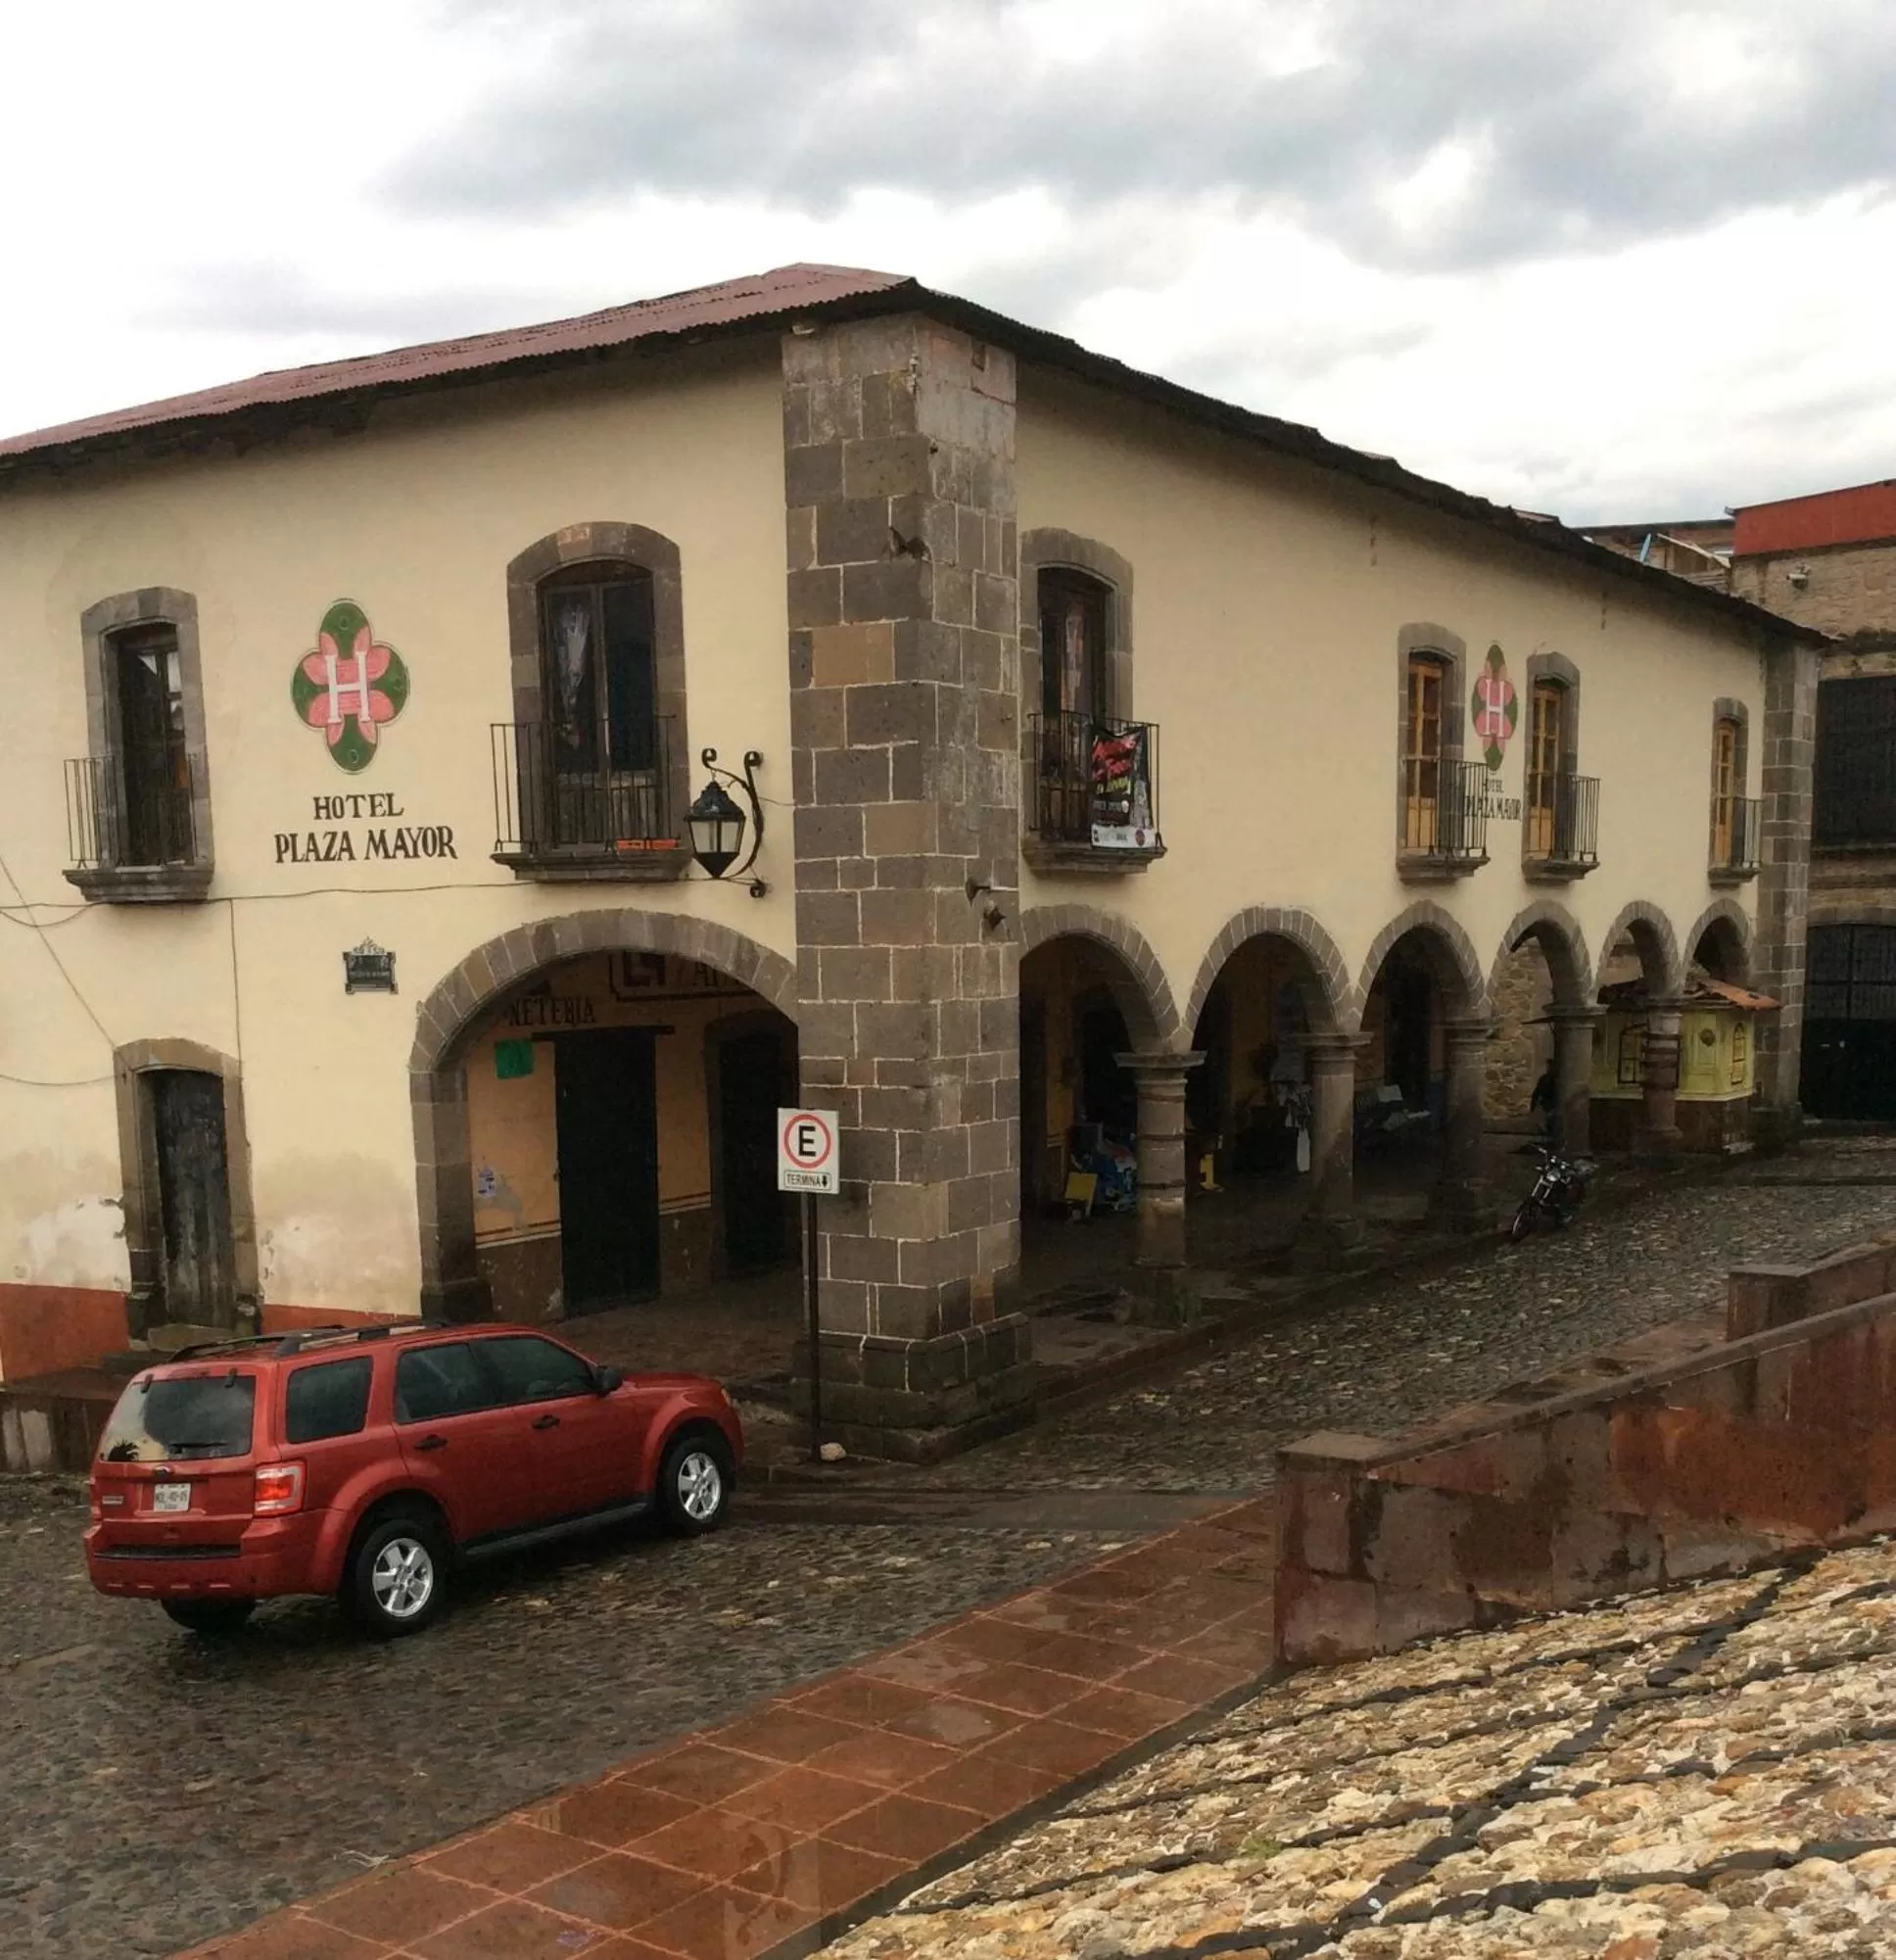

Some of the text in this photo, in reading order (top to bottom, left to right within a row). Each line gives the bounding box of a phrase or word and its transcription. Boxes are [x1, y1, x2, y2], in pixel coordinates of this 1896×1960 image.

[312, 792, 404, 821] HOTEL
[273, 825, 458, 864] PLAZA MAYOR
[798, 1124, 817, 1157] E
[786, 1172, 822, 1188] TERMINA
